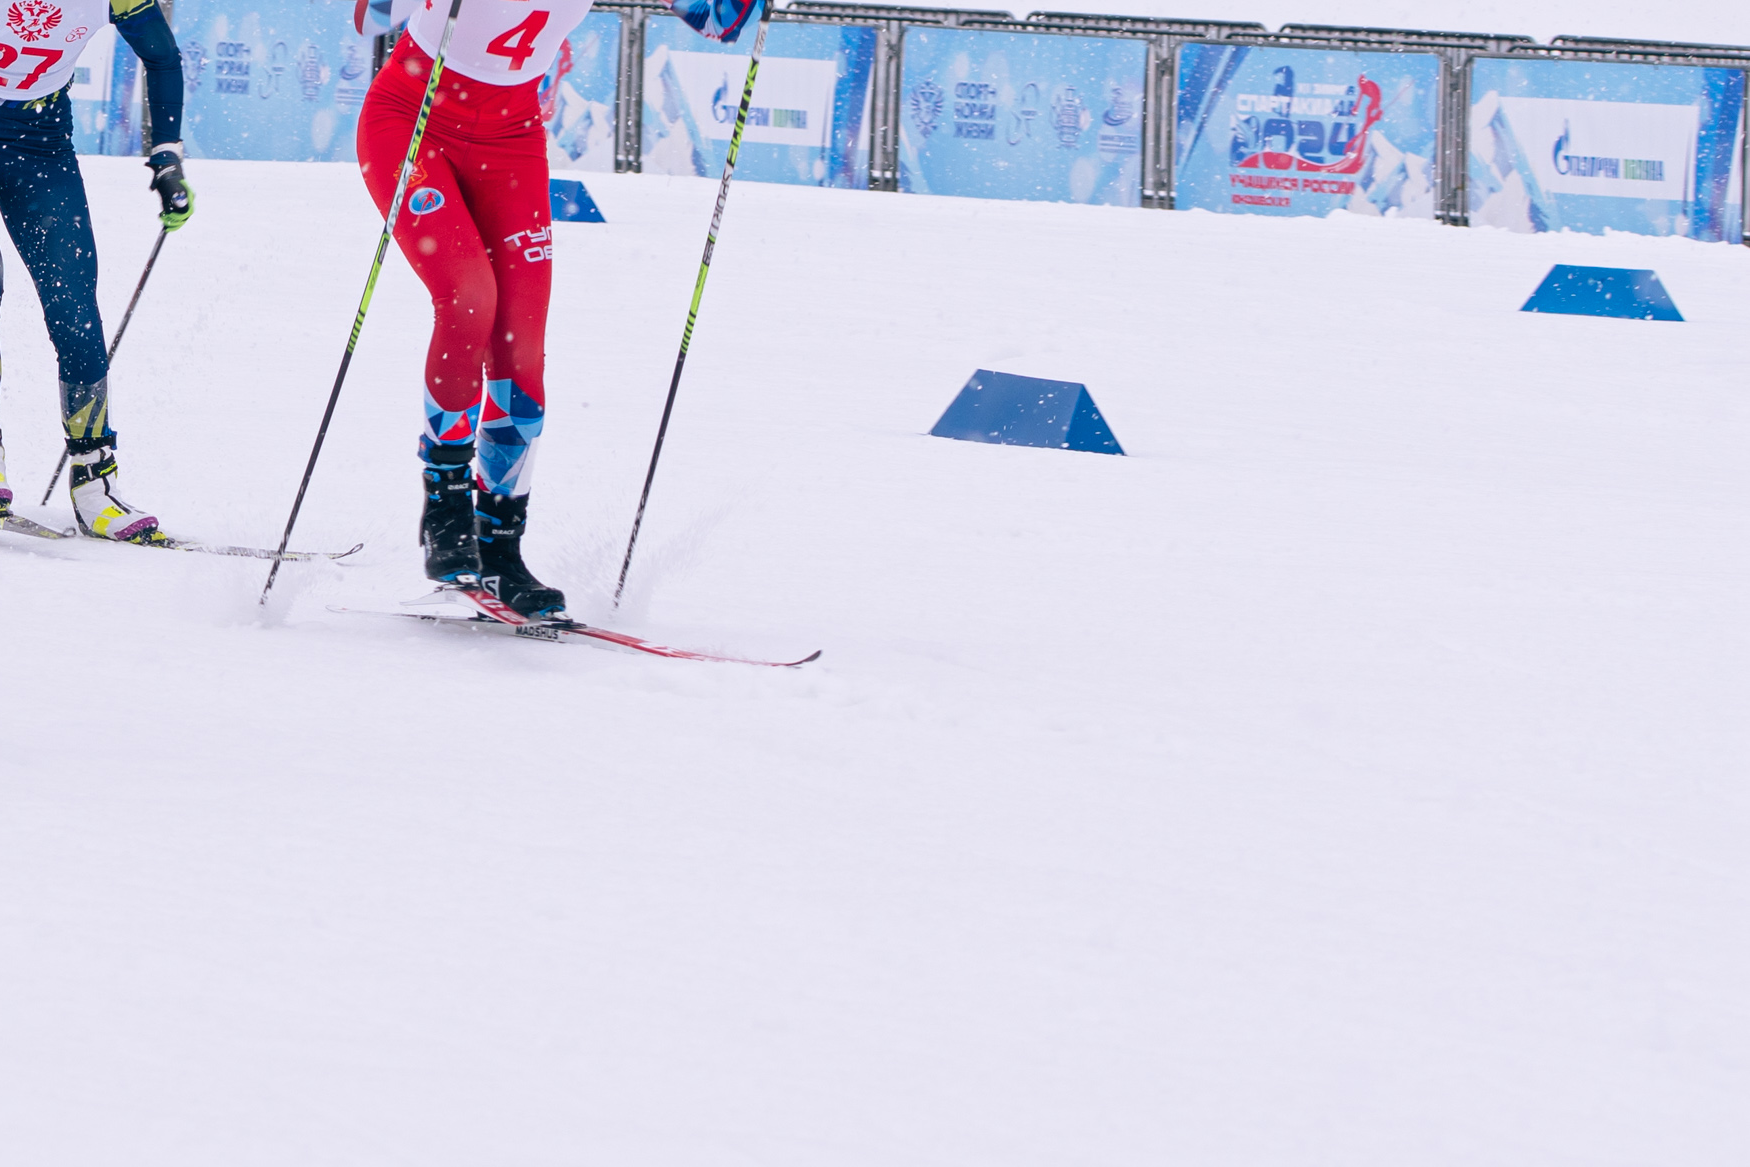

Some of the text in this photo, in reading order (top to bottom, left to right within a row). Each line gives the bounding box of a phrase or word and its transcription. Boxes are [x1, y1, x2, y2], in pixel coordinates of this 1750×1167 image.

[486, 9, 550, 71] 4
[1301, 179, 1356, 195] РОССИИ
[515, 625, 559, 640] MADSHUS
